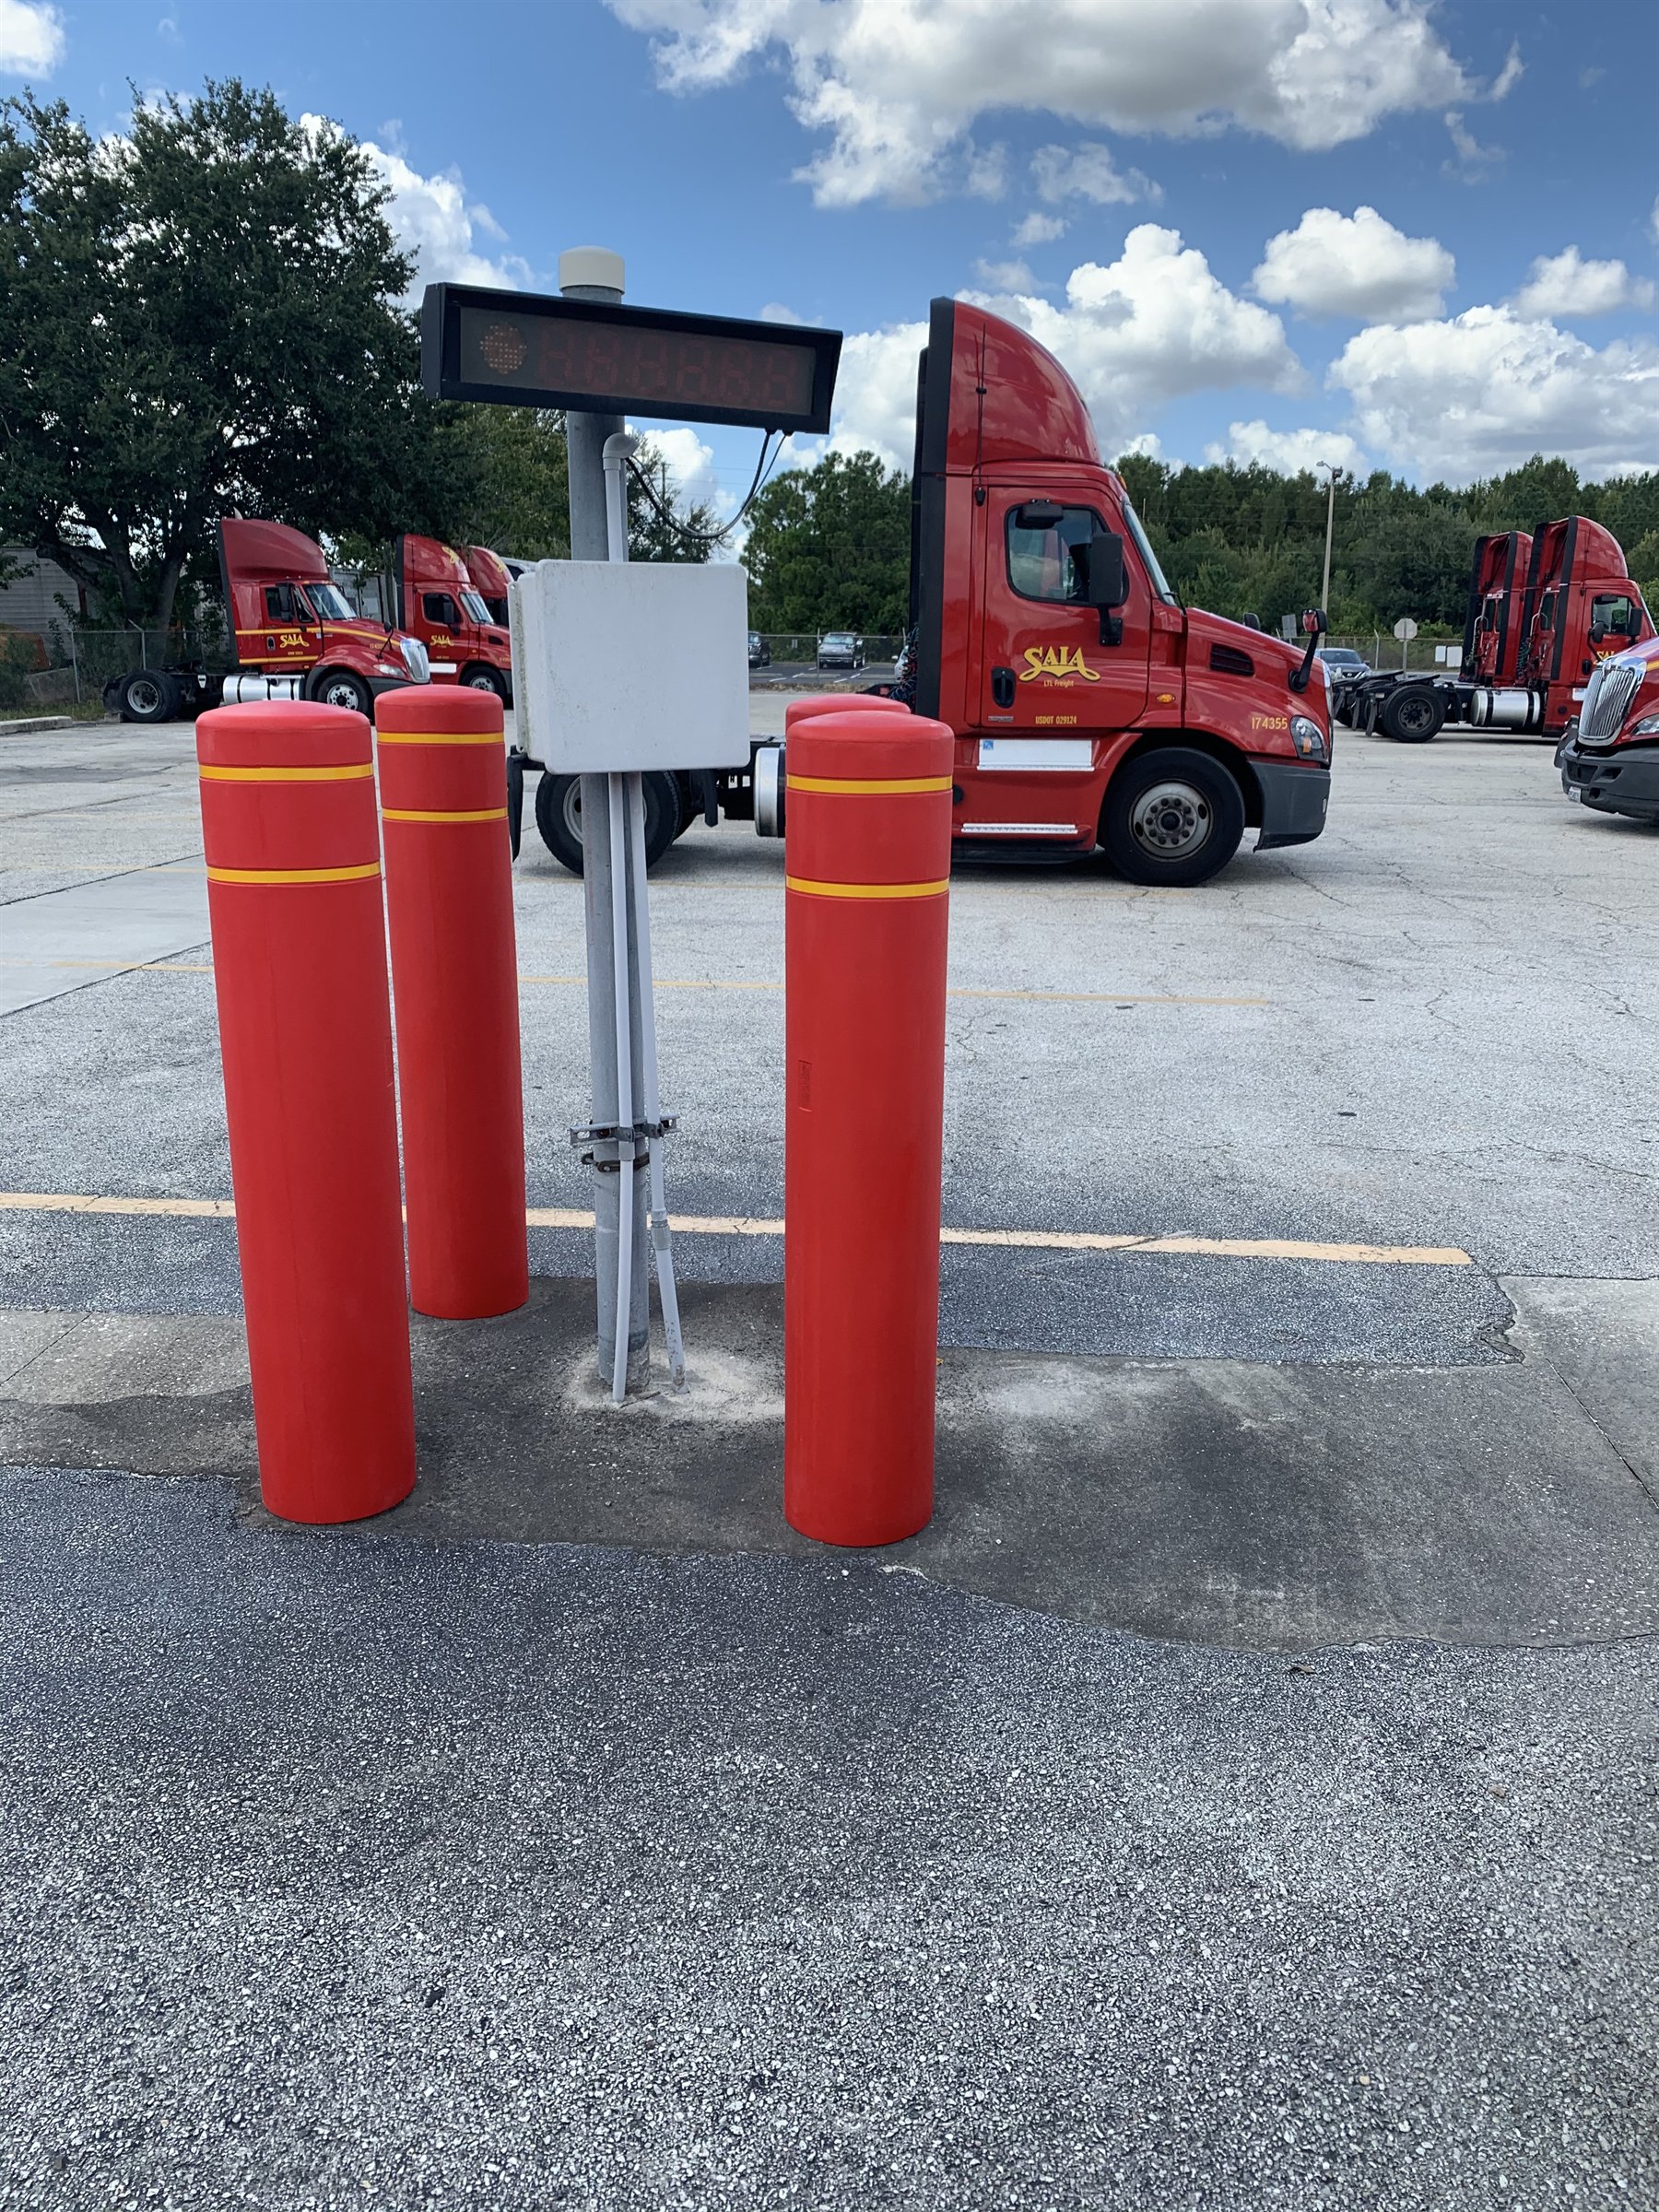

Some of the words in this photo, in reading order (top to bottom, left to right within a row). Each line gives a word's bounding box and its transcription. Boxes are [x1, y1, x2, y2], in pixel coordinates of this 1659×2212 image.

[279, 633, 310, 649] SAIA
[429, 634, 454, 646] SAIA
[1018, 645, 1101, 682] SAIA
[1043, 679, 1053, 688] LTL
[1054, 678, 1075, 688] Freight
[1035, 715, 1054, 724] USDOT
[1252, 716, 1288, 730] 174355
